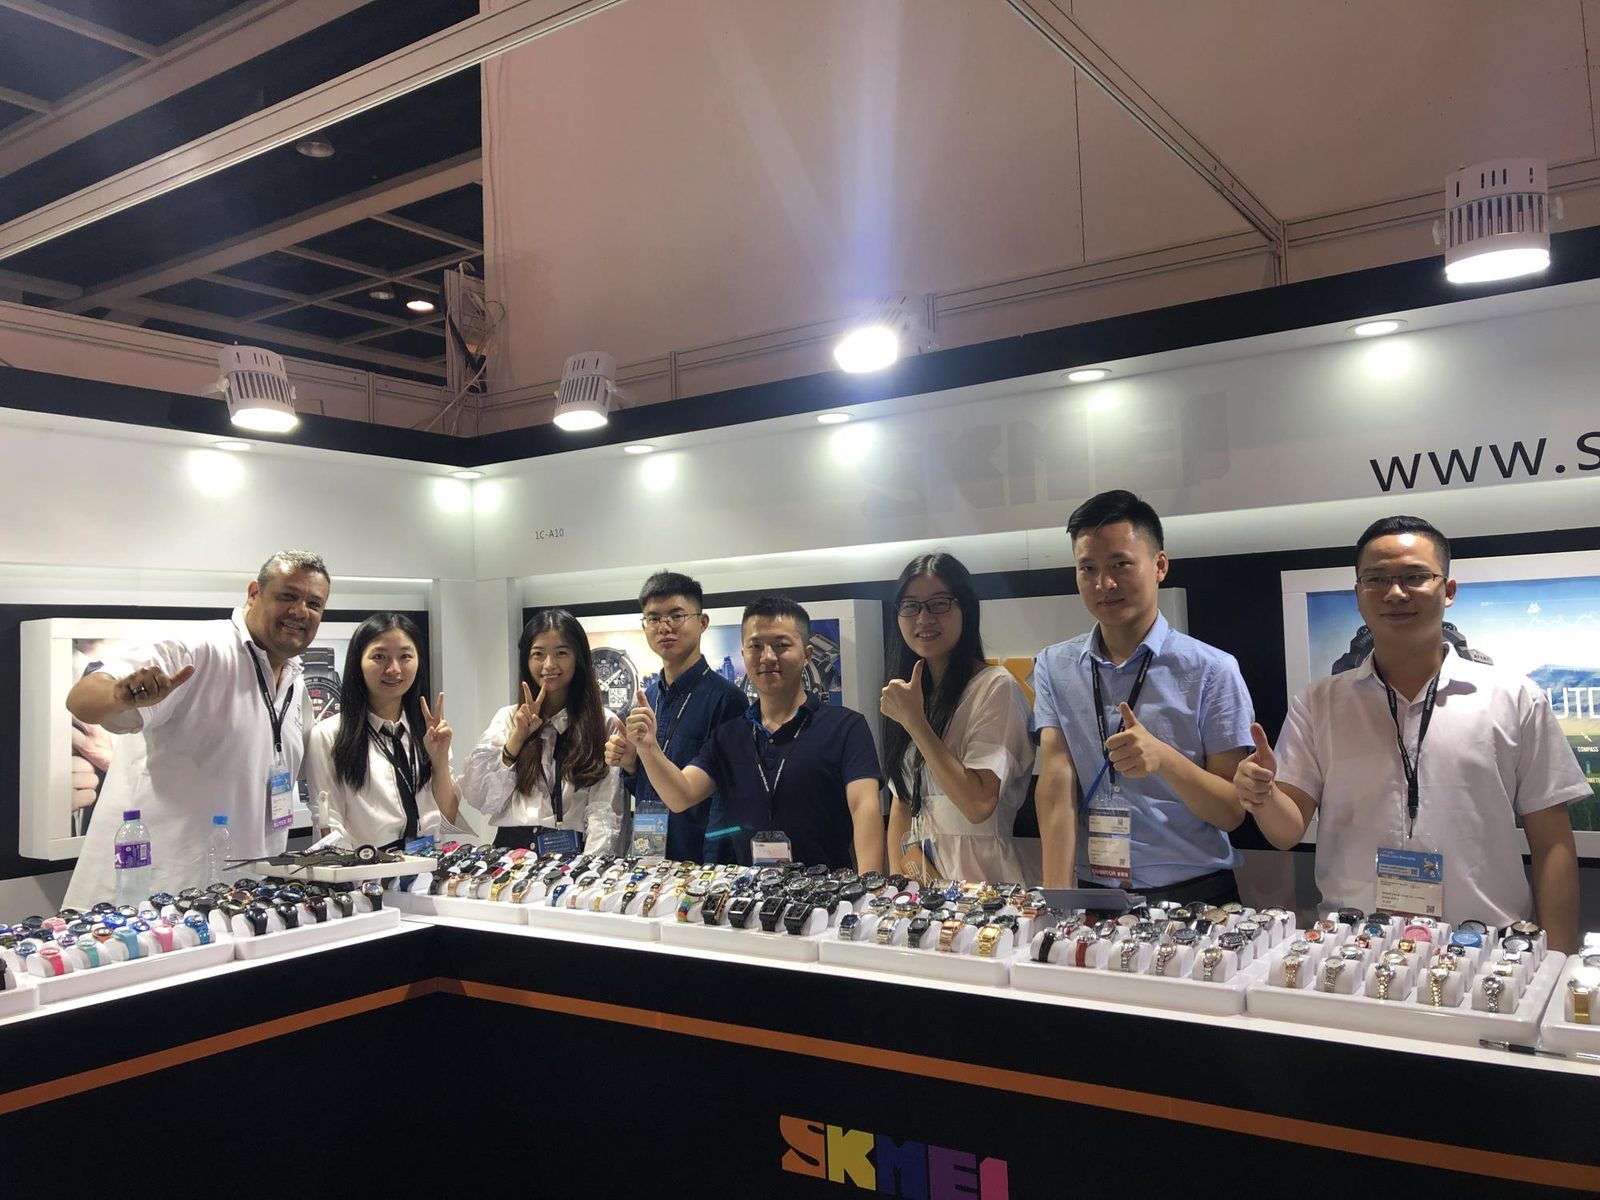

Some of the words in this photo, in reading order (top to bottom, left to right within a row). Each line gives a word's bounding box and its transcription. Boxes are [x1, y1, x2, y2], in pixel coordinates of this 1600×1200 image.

[1369, 431, 1600, 492] www.s
[535, 528, 564, 540] 1C-A10
[779, 1115, 1010, 1200] SKMEI
